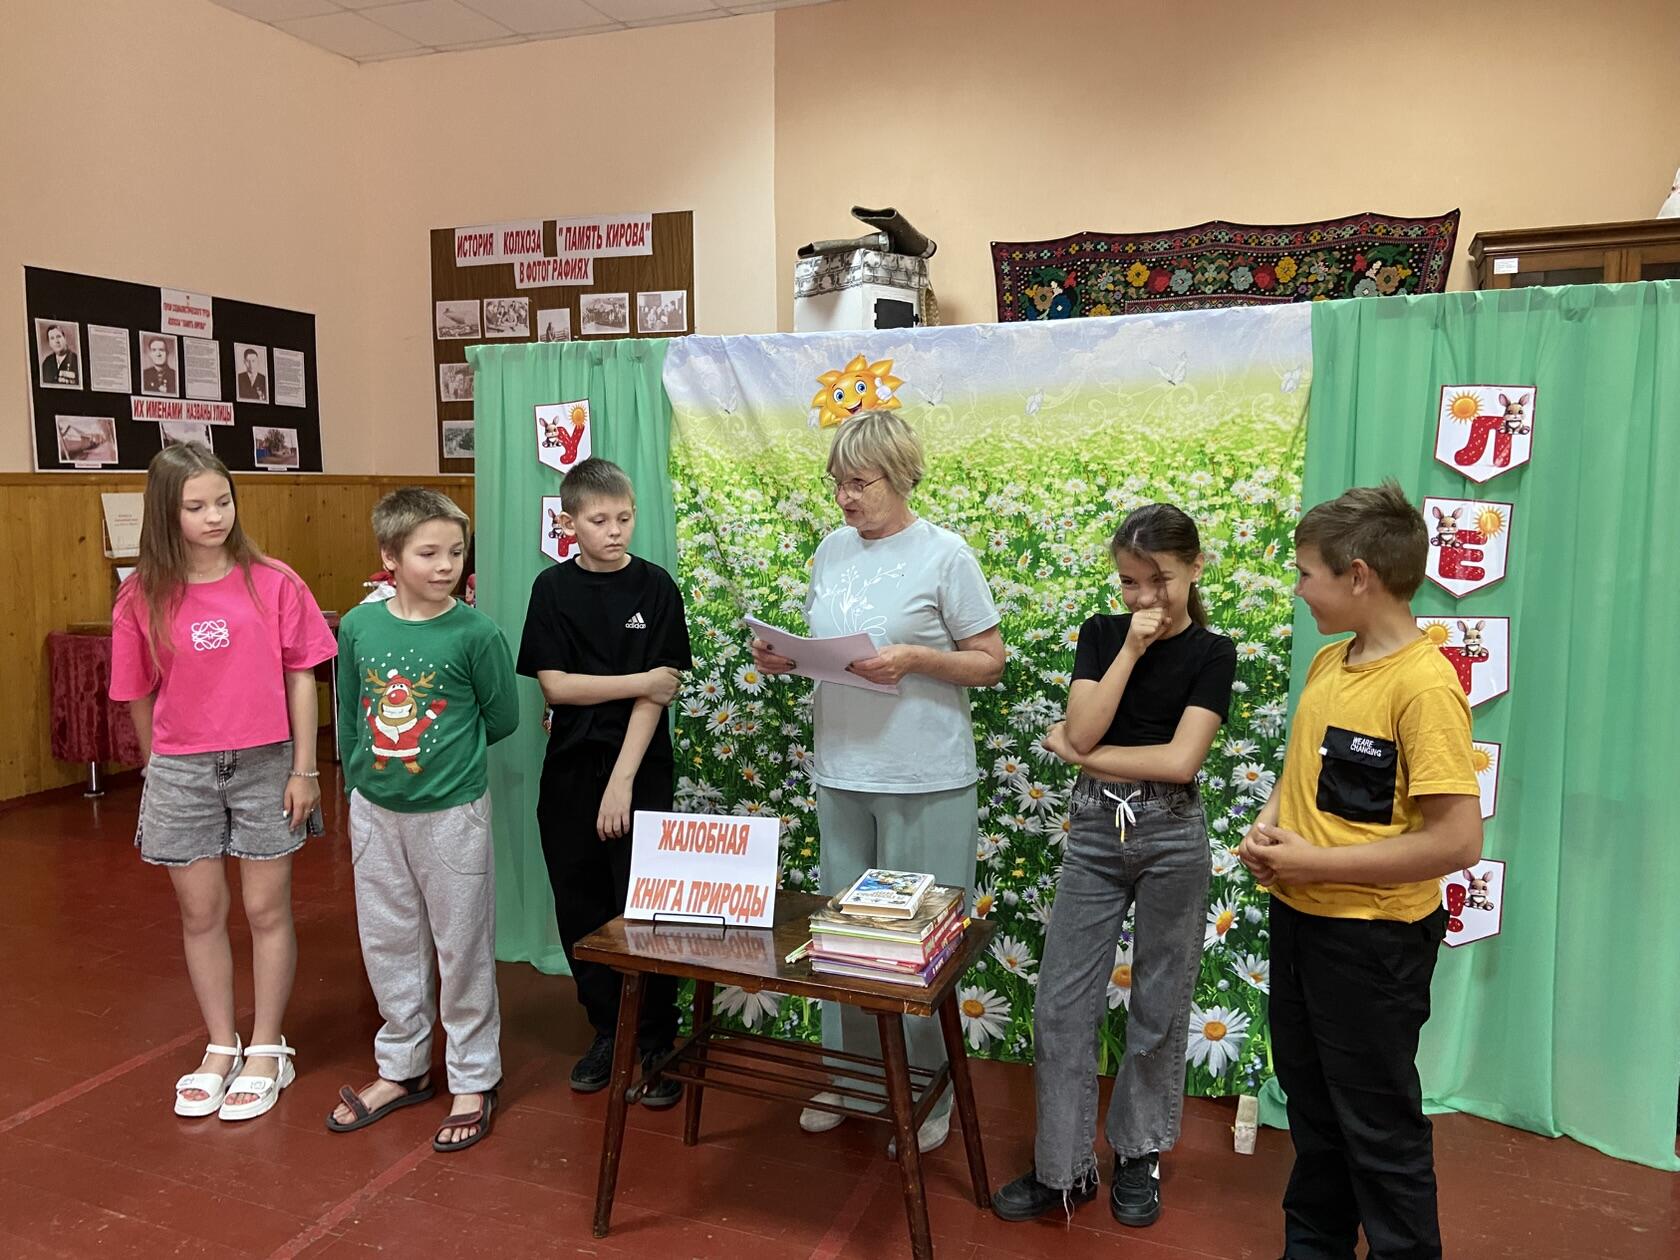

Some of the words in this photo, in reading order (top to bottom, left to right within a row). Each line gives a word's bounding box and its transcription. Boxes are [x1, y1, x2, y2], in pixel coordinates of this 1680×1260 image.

[457, 233, 494, 258] ИСТОРИЯ
[503, 230, 542, 255] КОЛХОЗА
[605, 222, 650, 248] КИРОВА"
[519, 262, 525, 283] В
[134, 400, 145, 418] ИХ
[146, 401, 183, 419] ИМЕНАМИ
[557, 424, 586, 465] У
[1454, 416, 1513, 467] Л
[1438, 529, 1488, 581] Е
[1350, 744, 1382, 757] CHANGING
[658, 819, 751, 856] ЖАЛОБНАЯ
[630, 877, 685, 912] КНИГА
[686, 880, 769, 923] ПРИРОДЫ
